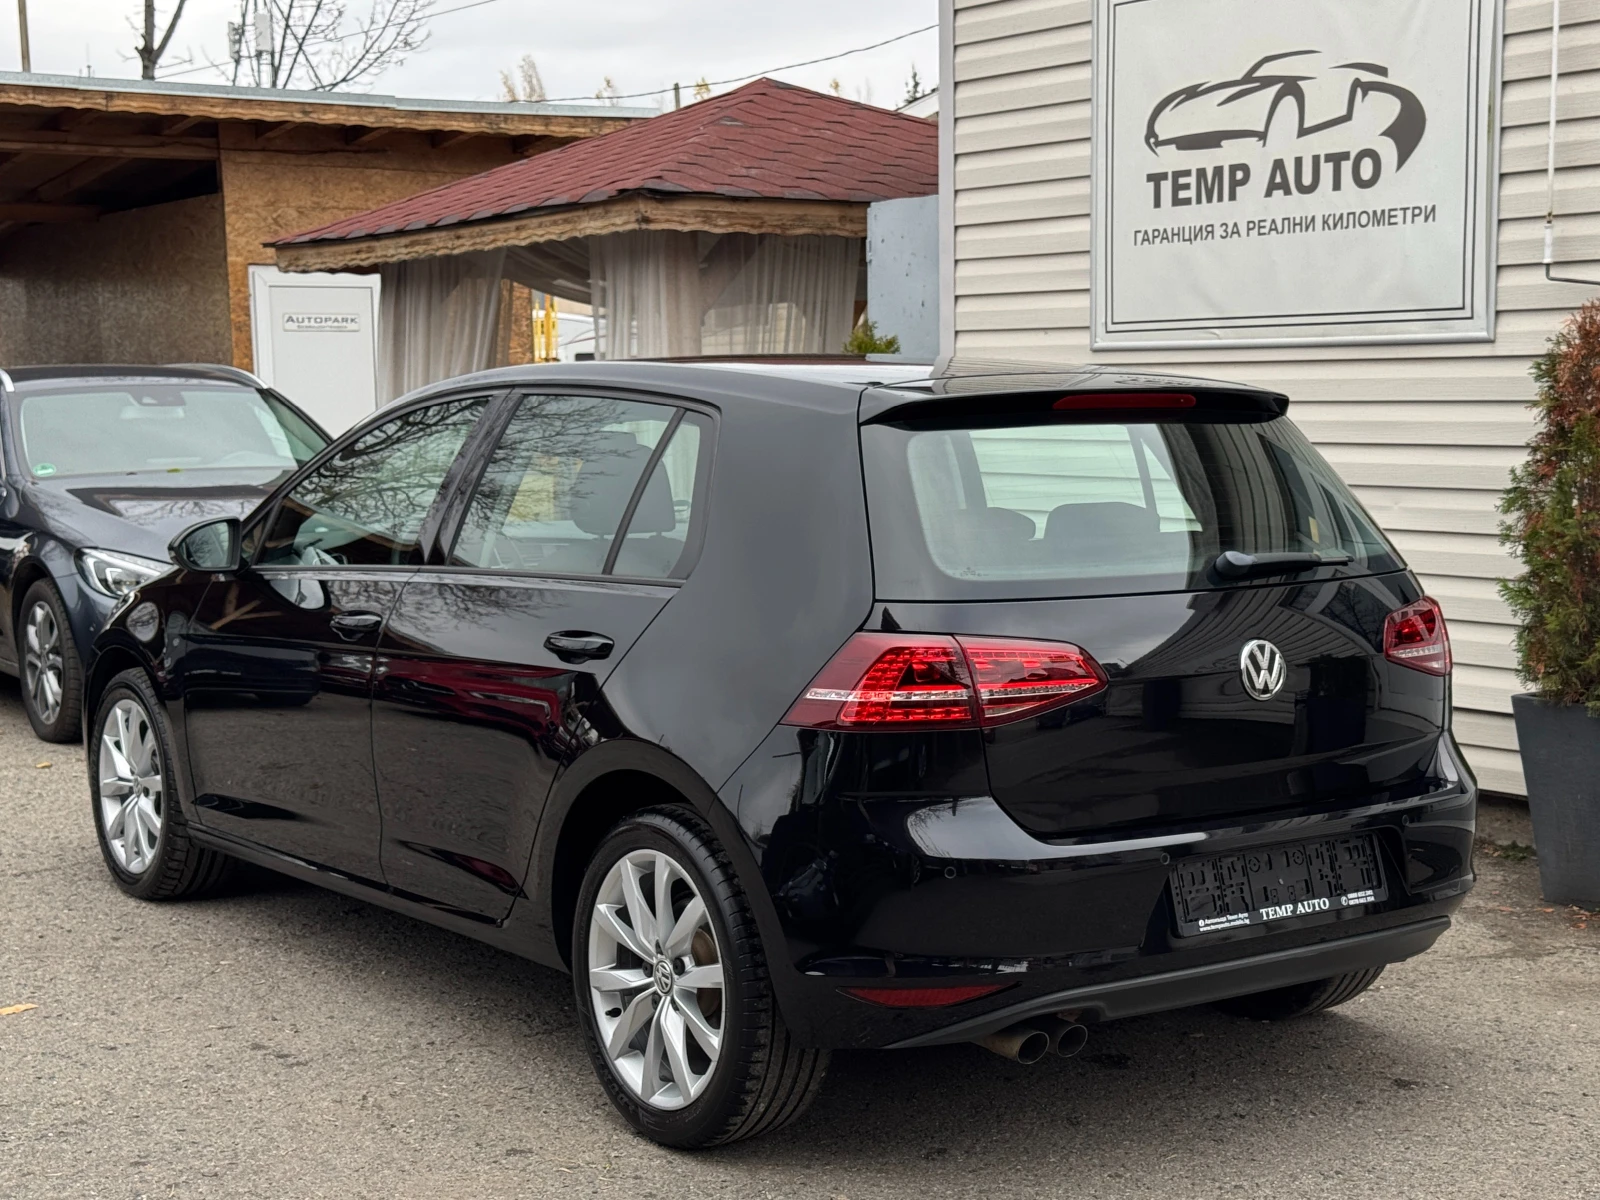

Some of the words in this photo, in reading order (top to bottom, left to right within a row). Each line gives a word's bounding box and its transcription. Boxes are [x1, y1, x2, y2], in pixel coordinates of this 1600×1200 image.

[1146, 162, 1251, 209] TEMP
[1264, 148, 1382, 198] AUTO
[1134, 224, 1215, 246] ГАРАНЦИЯ
[1219, 222, 1241, 240] ЗА
[1246, 215, 1316, 237] РЕАЛНИ
[1322, 204, 1436, 231] КИЛОМЕТРИ
[1260, 904, 1294, 920] TEMP
[1296, 898, 1329, 914] AUTO
